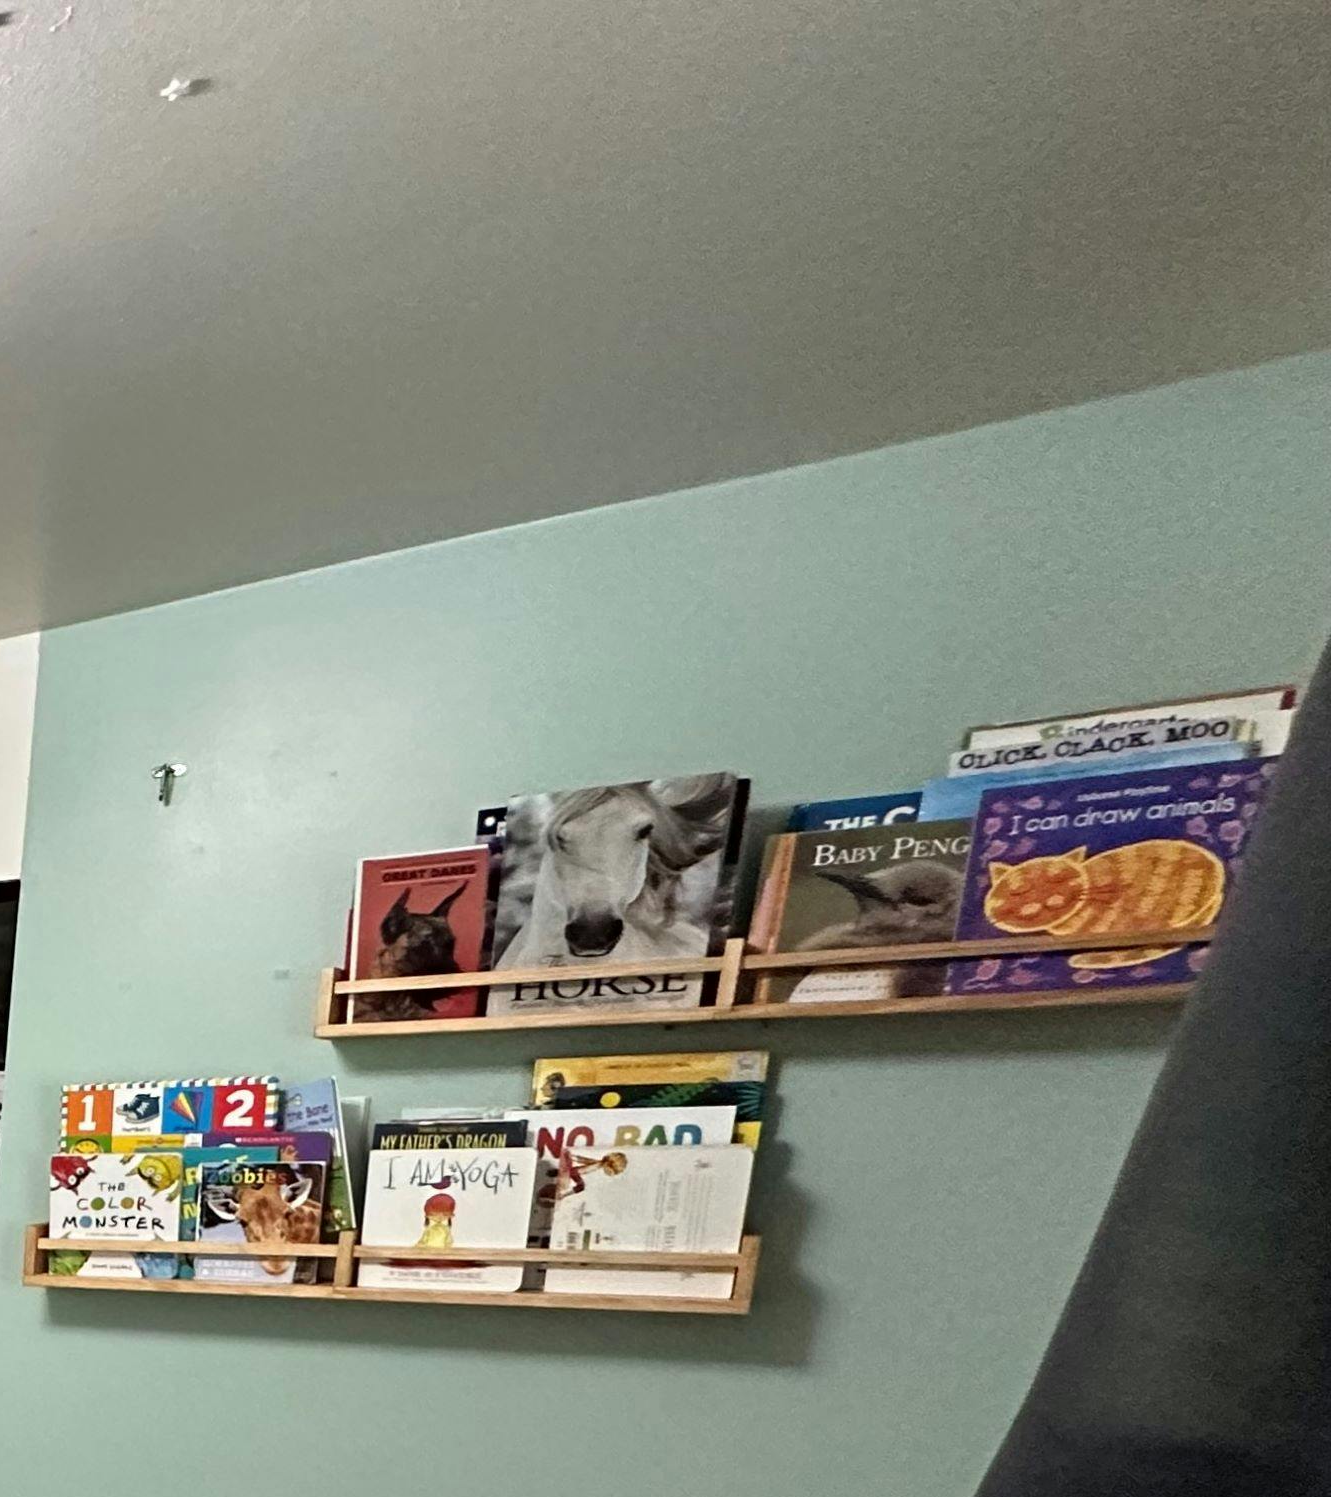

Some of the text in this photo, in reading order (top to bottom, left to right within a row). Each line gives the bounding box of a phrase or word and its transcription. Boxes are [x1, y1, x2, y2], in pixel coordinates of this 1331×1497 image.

[1164, 720, 1229, 743] MOO
[1025, 812, 1069, 833] can
[1073, 805, 1142, 828] draw
[1145, 792, 1237, 820] animals
[811, 843, 884, 867] BABY
[539, 1125, 594, 1159] NO
[98, 1182, 126, 1192] THE
[452, 1157, 520, 1195] YOGA
[62, 1214, 166, 1231] MONSTER
